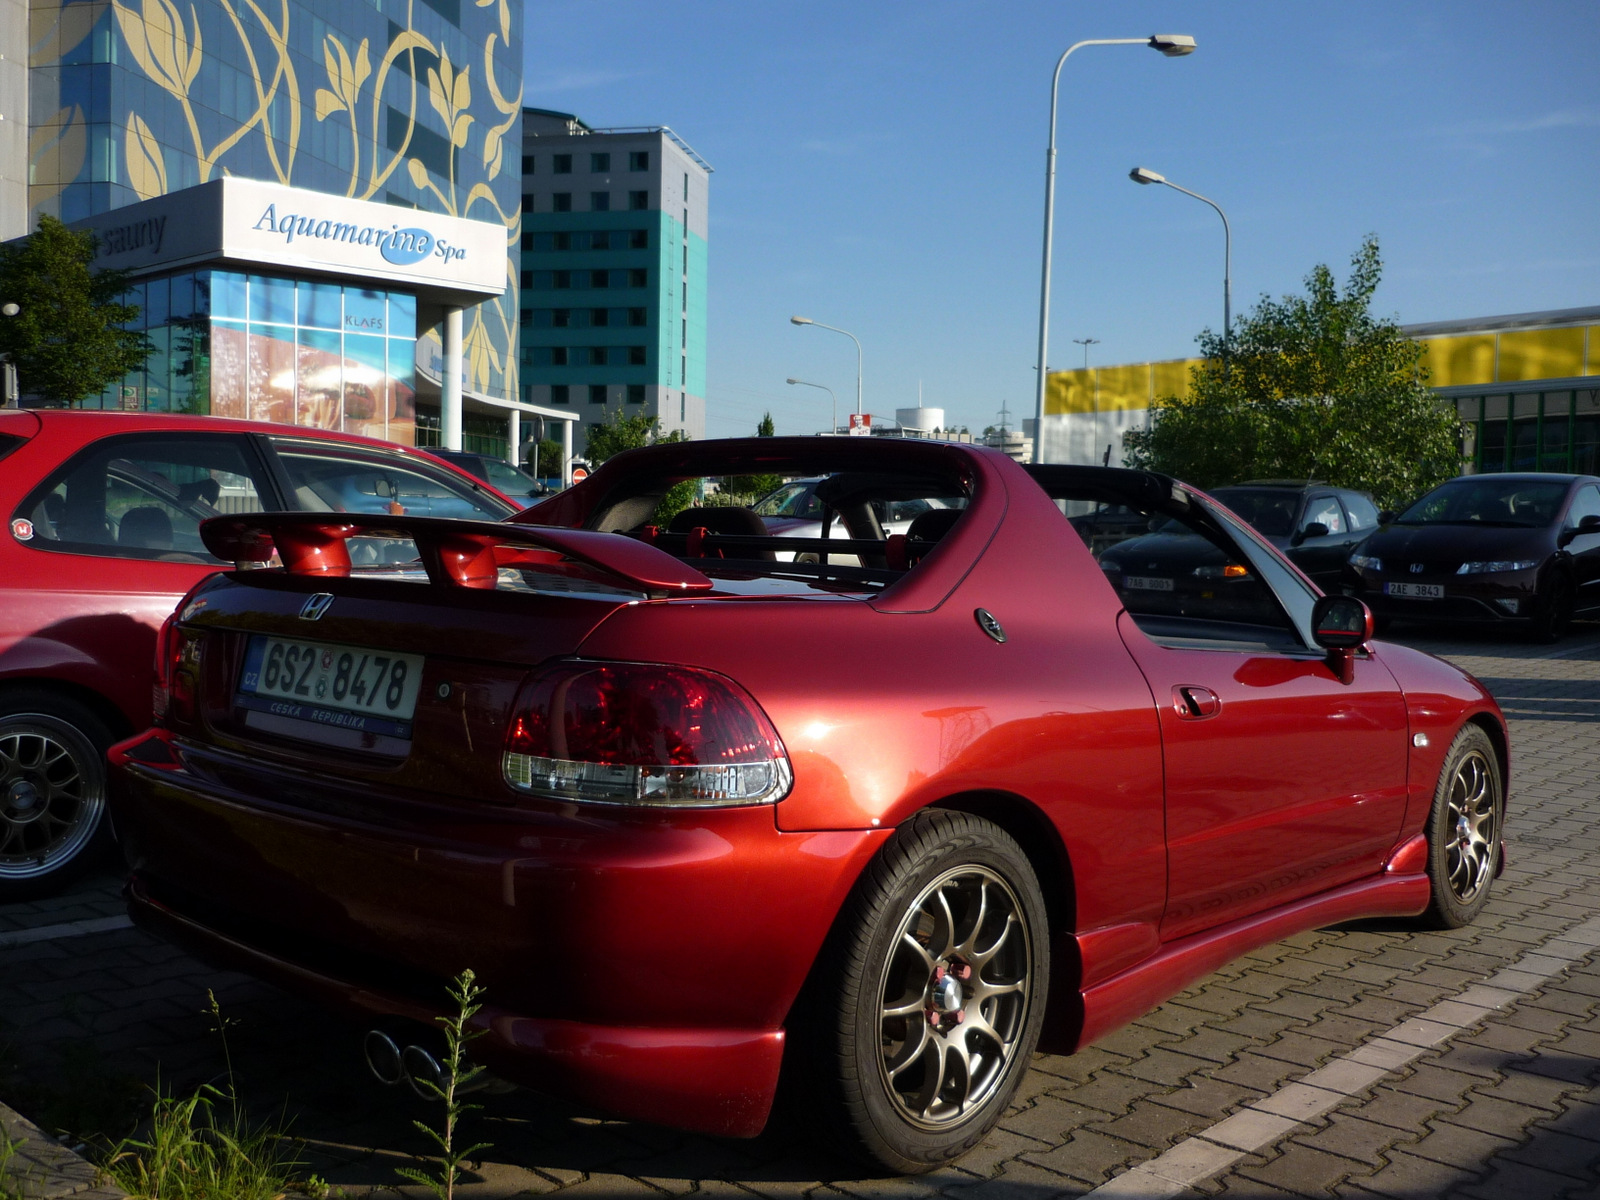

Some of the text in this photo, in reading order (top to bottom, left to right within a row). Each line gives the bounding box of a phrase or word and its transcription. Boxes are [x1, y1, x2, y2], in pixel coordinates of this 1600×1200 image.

[253, 203, 467, 263] Aquamarine Spa
[345, 315, 383, 329] KLAFS
[1390, 584, 1439, 596] 2AE 3843
[244, 672, 258, 686] CZ
[264, 643, 408, 710] 6S2 8478
[311, 709, 366, 728] REPUBLIKA
